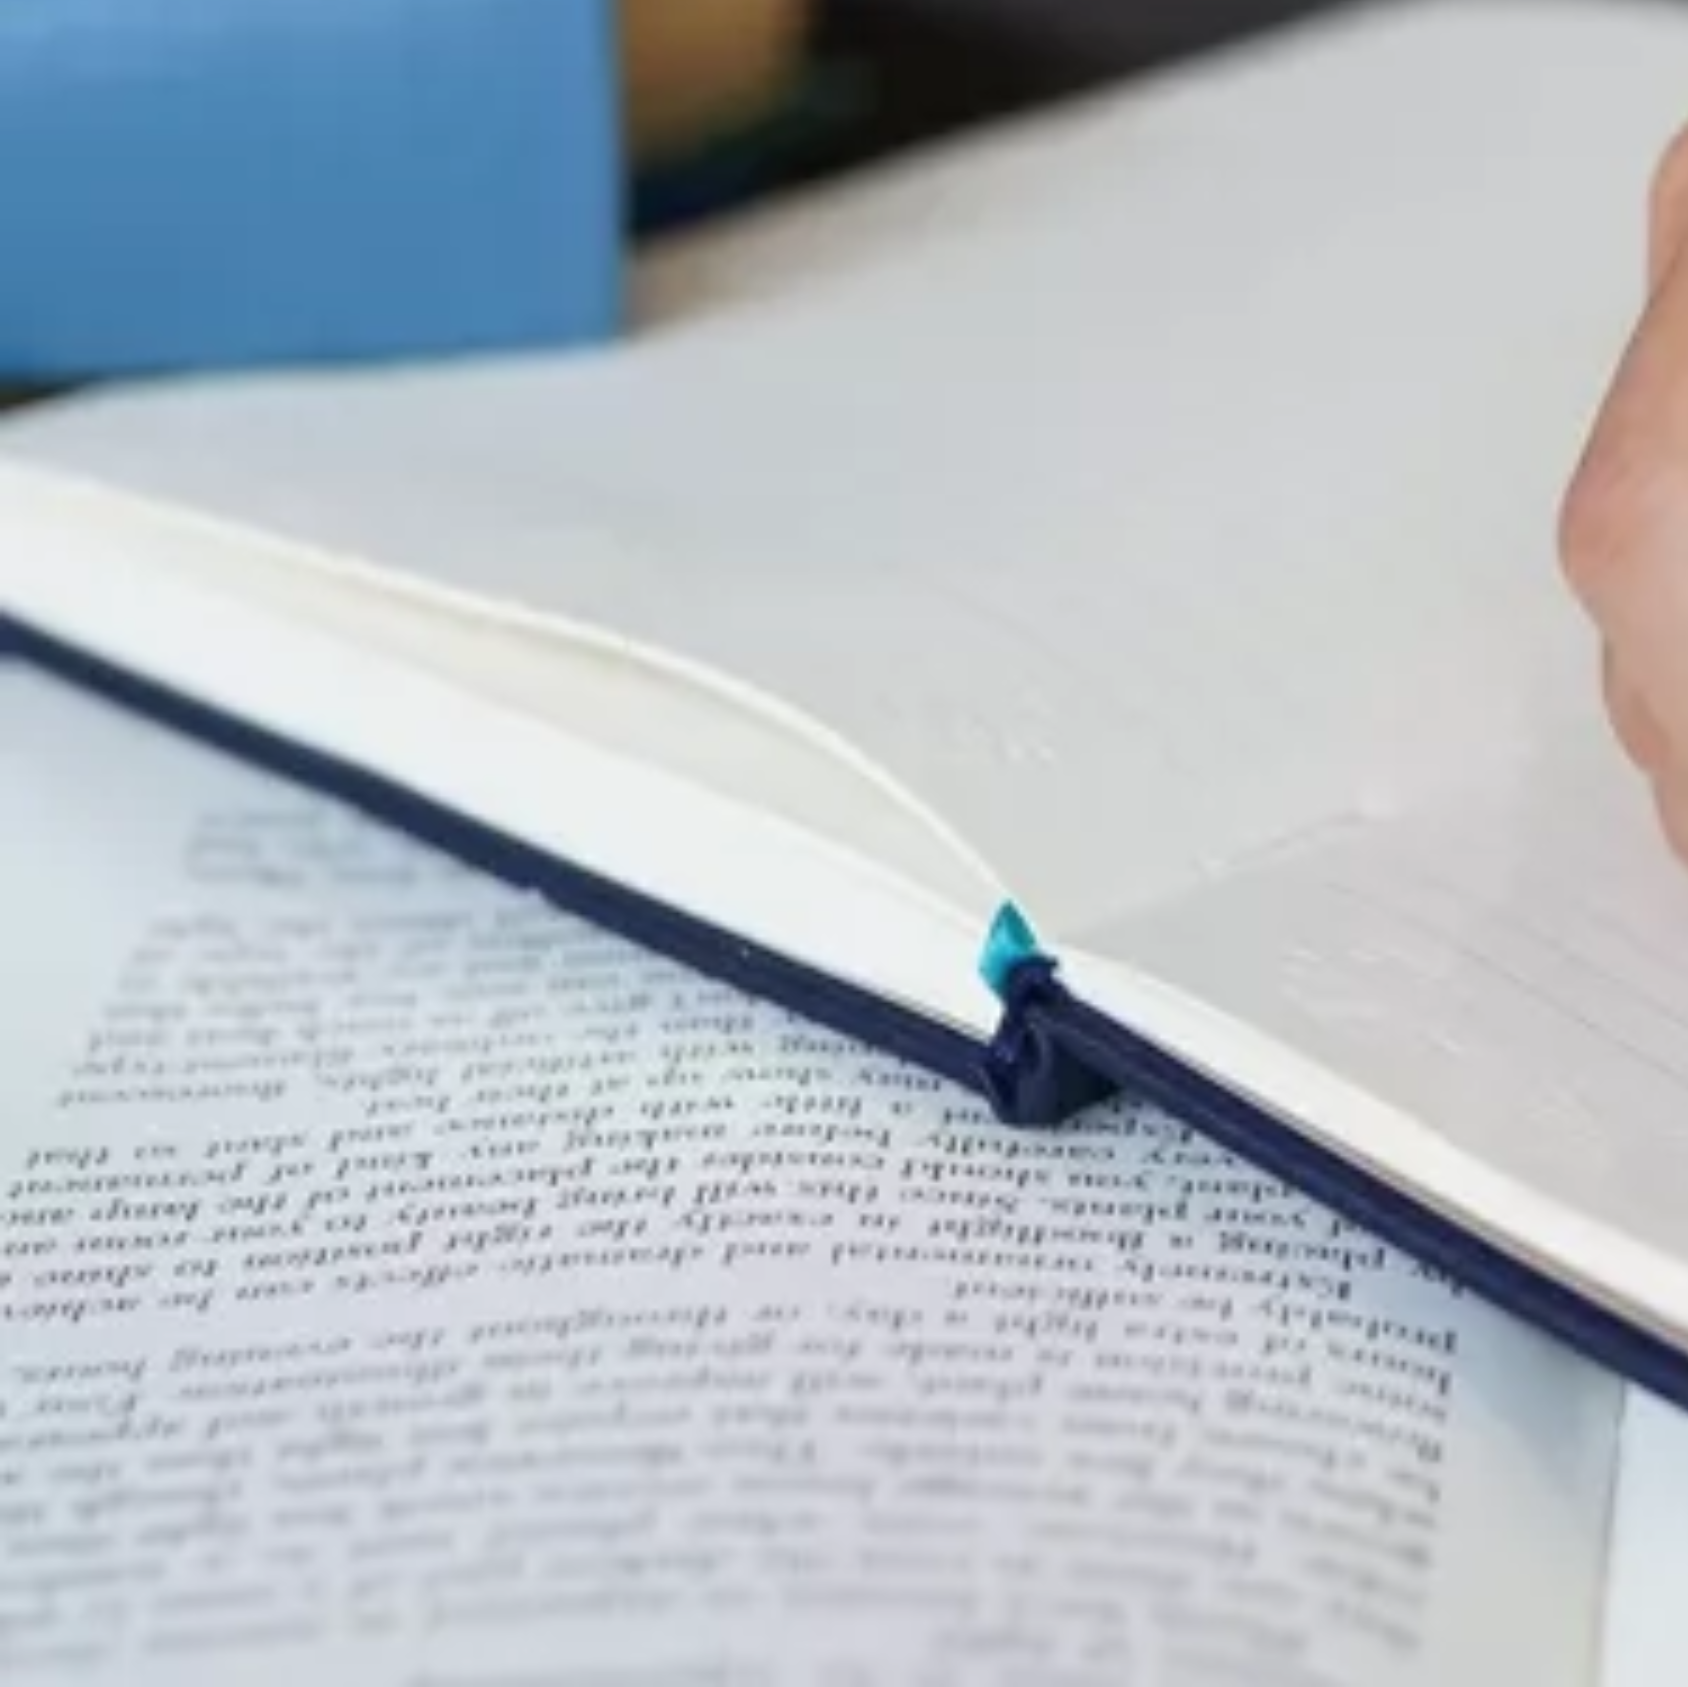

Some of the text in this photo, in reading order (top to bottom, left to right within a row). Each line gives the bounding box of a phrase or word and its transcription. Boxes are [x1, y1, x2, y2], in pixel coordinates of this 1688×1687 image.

[642, 1064, 702, 1093] up
[716, 1065, 836, 1089] show
[470, 1081, 572, 1107] their
[638, 1095, 736, 1121] with
[758, 1094, 864, 1122] little
[430, 1105, 618, 1137] distance
[890, 1099, 915, 1119] a
[200, 1134, 308, 1161] slant
[322, 1122, 415, 1155] and
[6, 1122, 1232, 1201] very carefully before making any kind of permanent
[24, 1145, 110, 1172] that
[608, 1155, 682, 1183] the
[700, 1150, 888, 1177] consider
[362, 1155, 596, 1203] placement
[898, 1157, 1052, 1190] should
[1066, 1167, 1150, 1193] you
[216, 1191, 288, 1217] the
[304, 1187, 352, 1215] of
[555, 1182, 678, 1211] bring
[691, 1176, 778, 1207] will
[794, 1179, 882, 1207] this
[897, 1185, 1020, 1217] Since
[88, 1194, 202, 1224] lamp
[322, 1212, 370, 1235] to
[394, 1195, 540, 1231] beauty
[676, 1205, 836, 1237] exactly
[1202, 1203, 1308, 1232] your
[206, 1213, 310, 1243] your
[442, 1223, 554, 1257] right
[576, 1215, 650, 1243] the
[858, 1212, 900, 1241] in
[928, 1217, 1146, 1253] floodlight
[70, 1229, 192, 1255] room
[242, 1229, 425, 1271] position
[722, 1240, 812, 1269] and
[1168, 1234, 1194, 1251] a
[1220, 1228, 1386, 1275] placing
[172, 1257, 220, 1279] to
[495, 1244, 705, 1278] dramatic
[831, 1241, 1096, 1275] ornamental
[32, 1263, 156, 1290] shine
[235, 1279, 318, 1301] can
[334, 1261, 482, 1294] effects
[1122, 1257, 1353, 1303] Extremely
[158, 1287, 216, 1317] be
[1180, 1297, 1236, 1323] be
[370, 1326, 447, 1352] the
[468, 1302, 728, 1347] throughout
[992, 1309, 1100, 1345] light
[1255, 1297, 1460, 1356] probably
[168, 1337, 352, 1375] evening
[1263, 1335, 1308, 1358] of
[1326, 1345, 1454, 1397] hours
